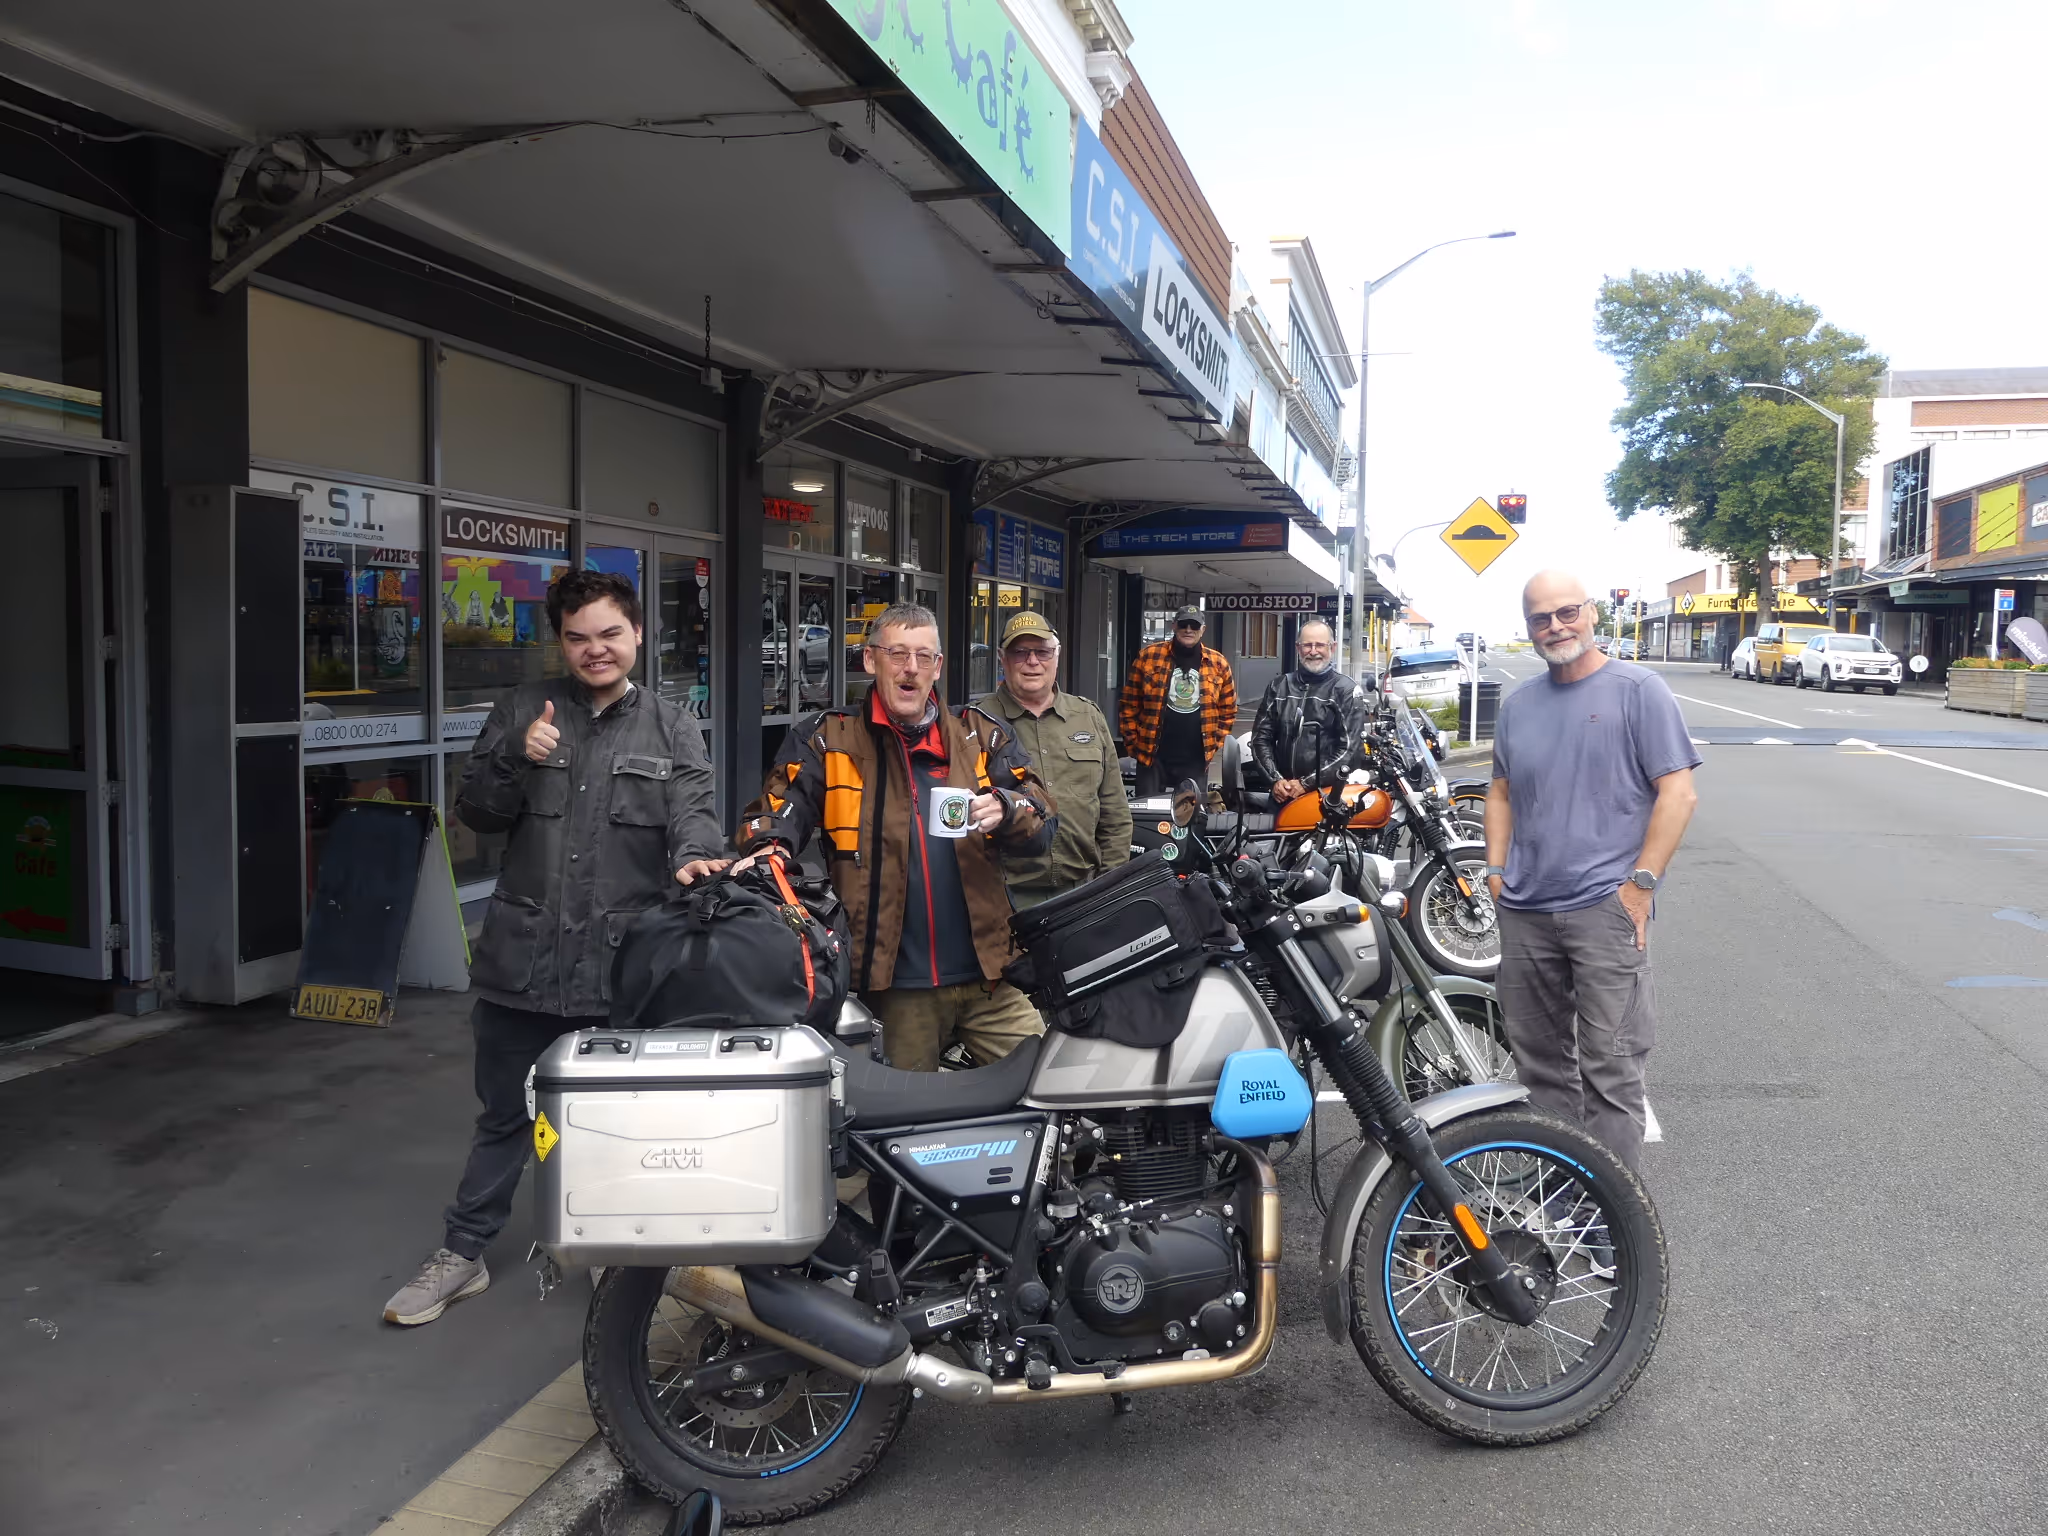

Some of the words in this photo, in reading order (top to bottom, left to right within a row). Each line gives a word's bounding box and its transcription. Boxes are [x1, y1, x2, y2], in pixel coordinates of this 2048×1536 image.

[446, 515, 566, 552] LOCKSMITH
[1123, 534, 1150, 543] THE
[1152, 533, 1188, 543] TECH
[1191, 531, 1236, 542] STORE
[1029, 553, 1060, 579] STORE
[1208, 595, 1313, 609] WOOLSHOP
[1707, 597, 1758, 609] Furnure
[350, 723, 374, 740] 000
[376, 721, 398, 738] 274
[443, 719, 487, 732] www.co
[1241, 1080, 1280, 1092] ROYAL
[1239, 1090, 1286, 1105] ENFIELD
[908, 1142, 947, 1154] HIMALAYAN
[922, 1144, 979, 1163] SCRAM
